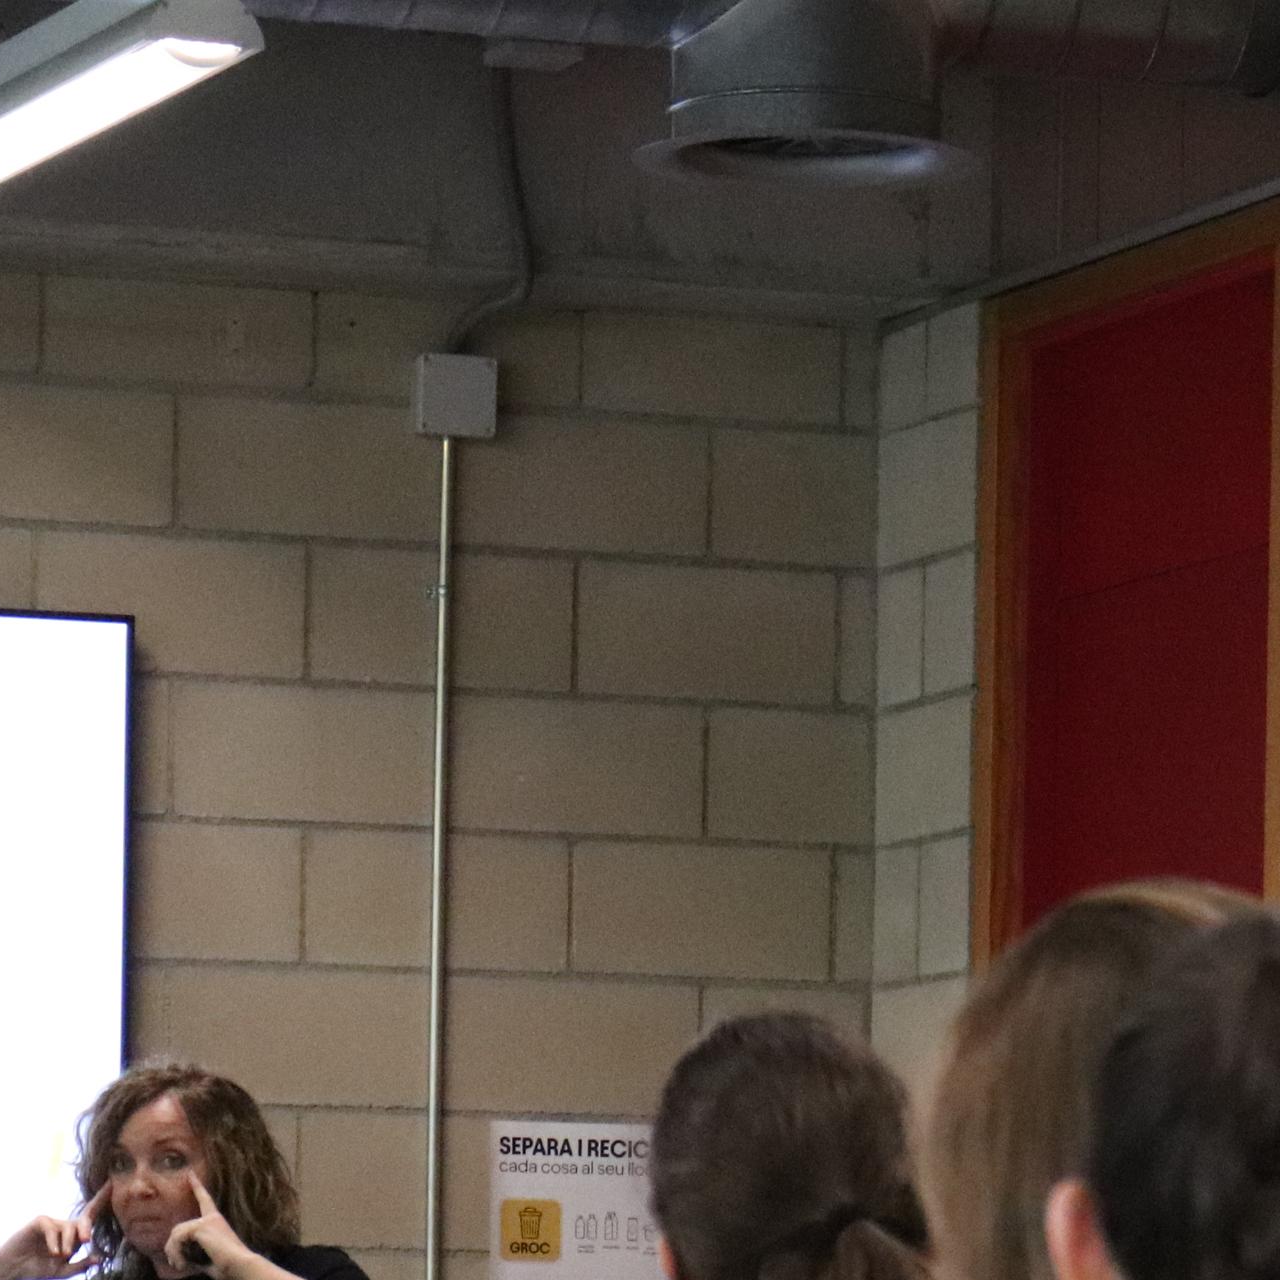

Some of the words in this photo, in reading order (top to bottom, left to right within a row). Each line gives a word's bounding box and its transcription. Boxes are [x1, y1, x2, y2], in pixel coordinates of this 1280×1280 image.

[499, 1136, 572, 1157] SEPARA
[578, 1139, 582, 1157] I
[499, 1160, 537, 1174] cada
[541, 1163, 578, 1175] cosa
[581, 1162, 594, 1175] al
[597, 1164, 624, 1176] seu
[510, 1242, 551, 1255] GROC
